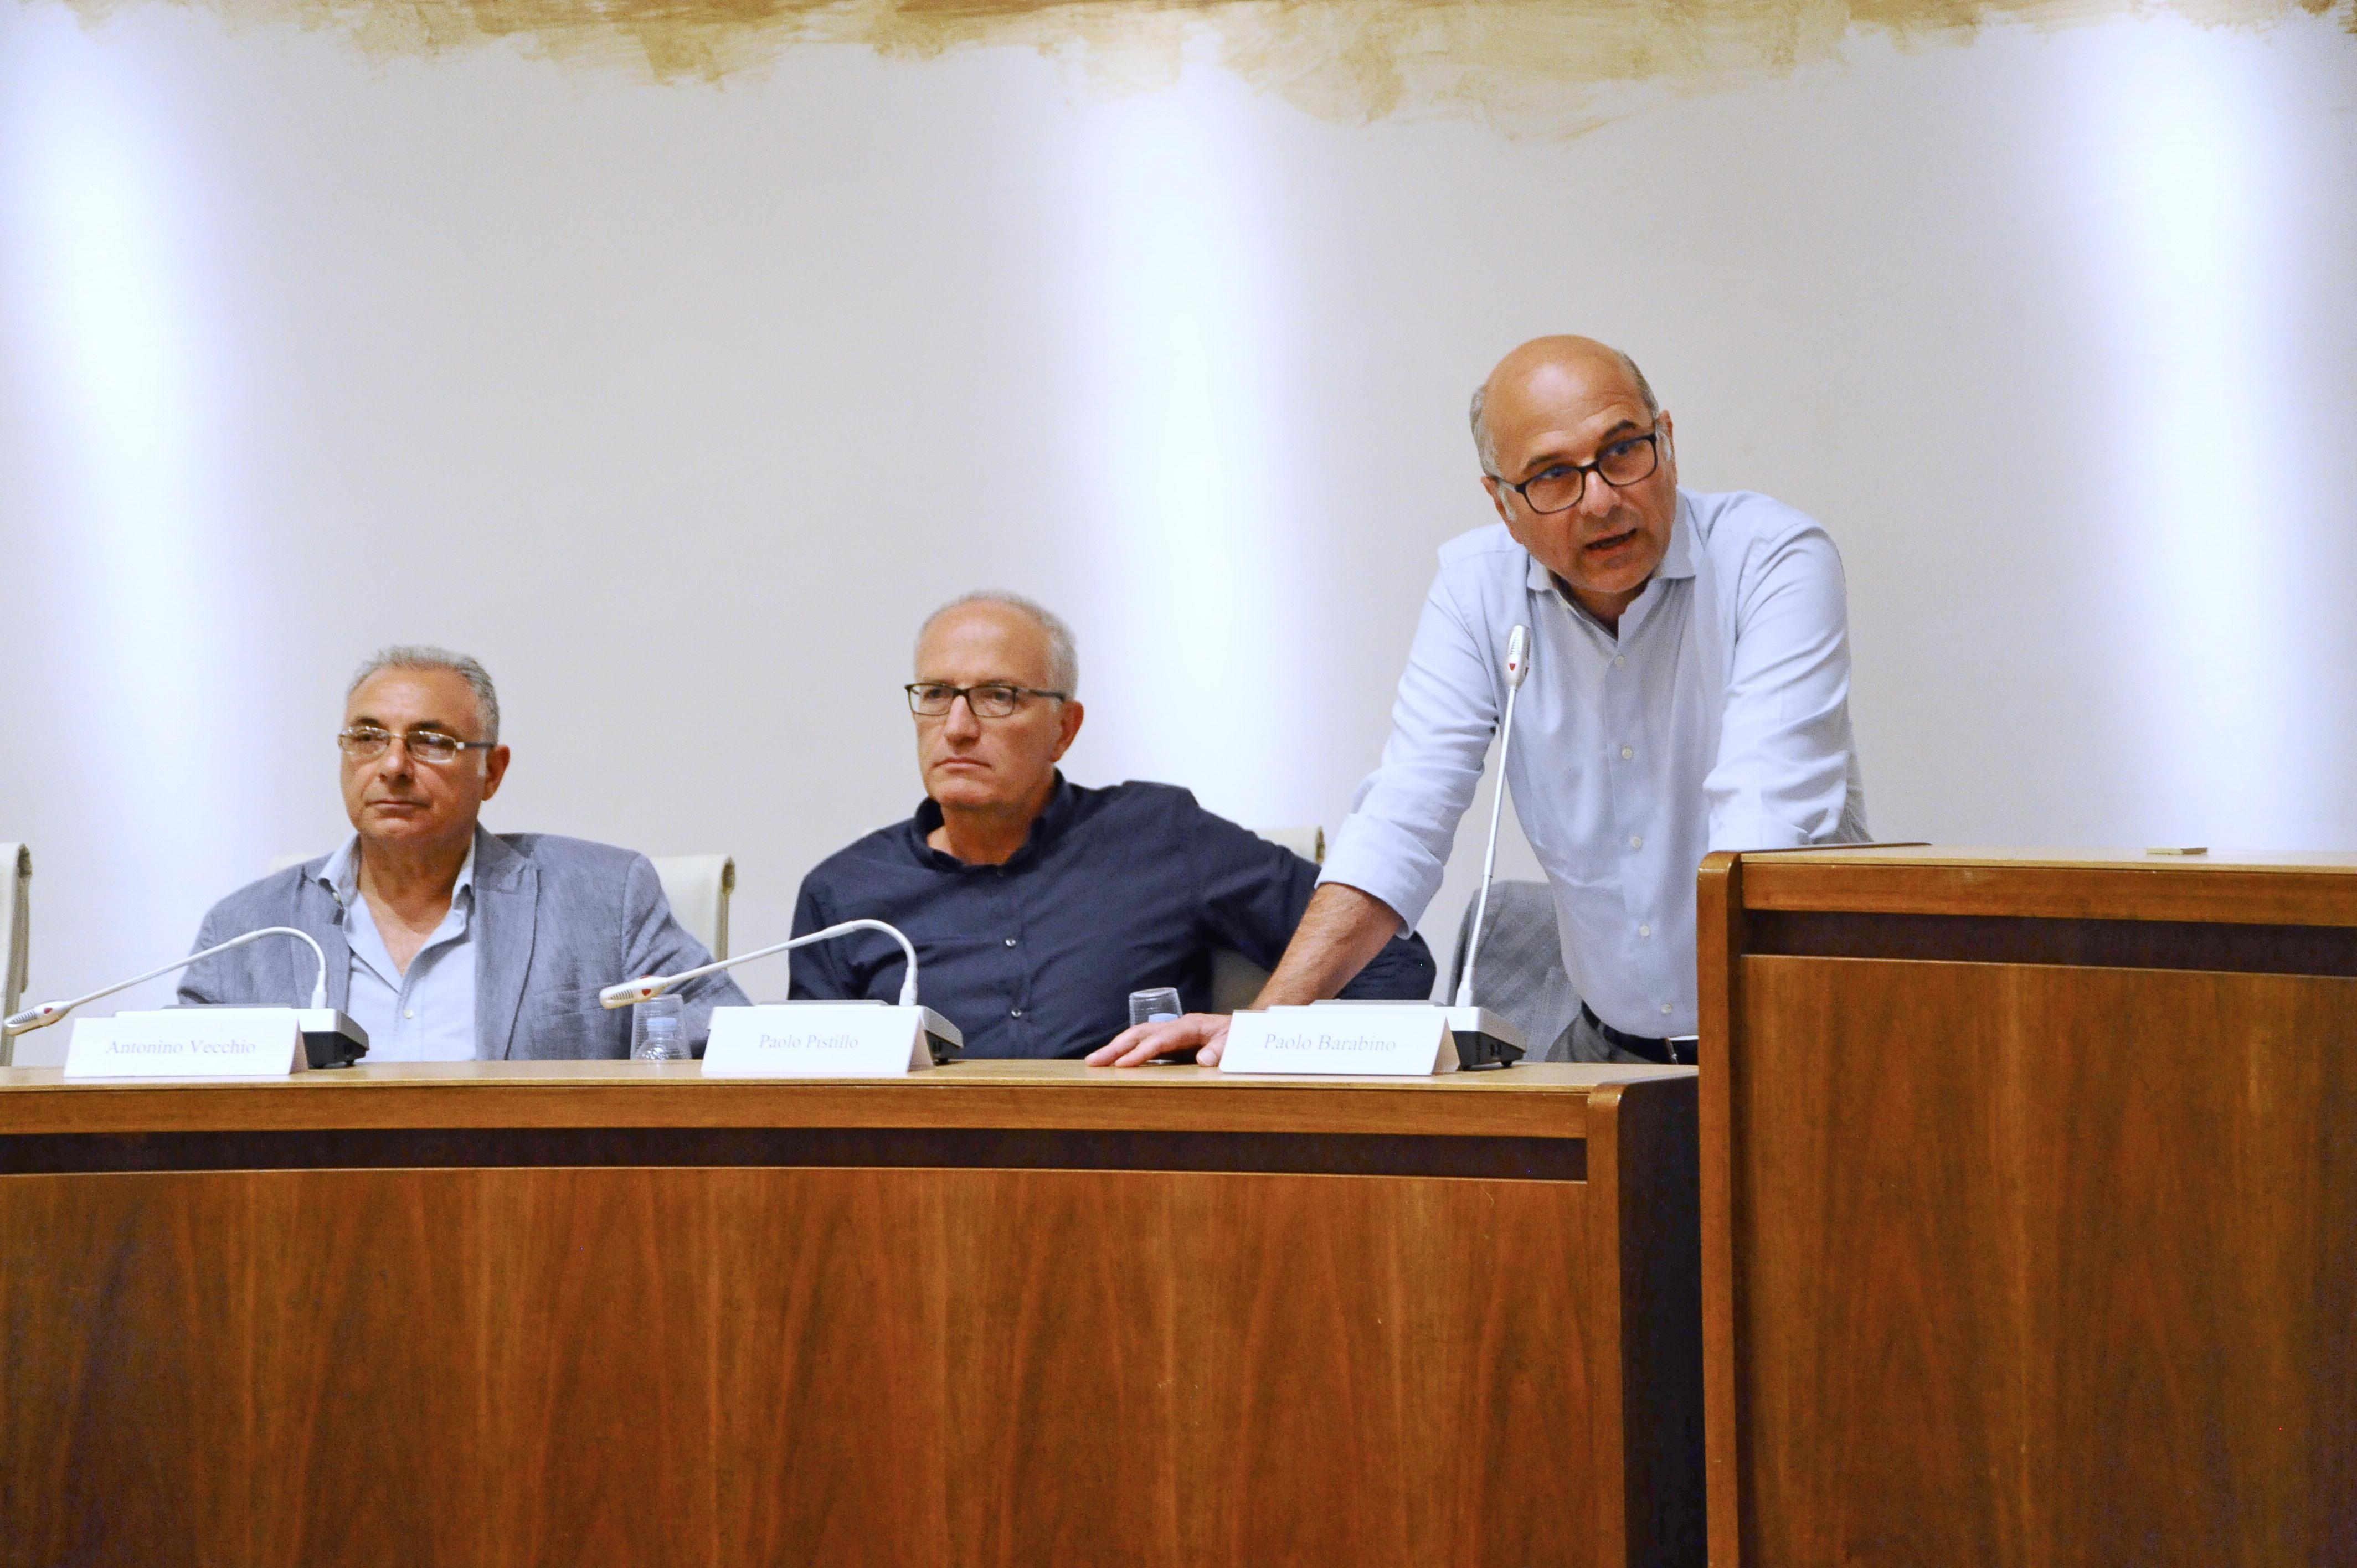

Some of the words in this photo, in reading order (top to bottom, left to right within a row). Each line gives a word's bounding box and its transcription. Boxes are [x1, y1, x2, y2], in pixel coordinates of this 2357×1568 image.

[106, 1039, 183, 1054] Antonino
[191, 1039, 256, 1054] Vecchio
[759, 1034, 801, 1049] Paolo
[806, 1034, 858, 1049] Pistillo
[1264, 1033, 1311, 1049] Paolo
[1318, 1034, 1396, 1051] Barabino
